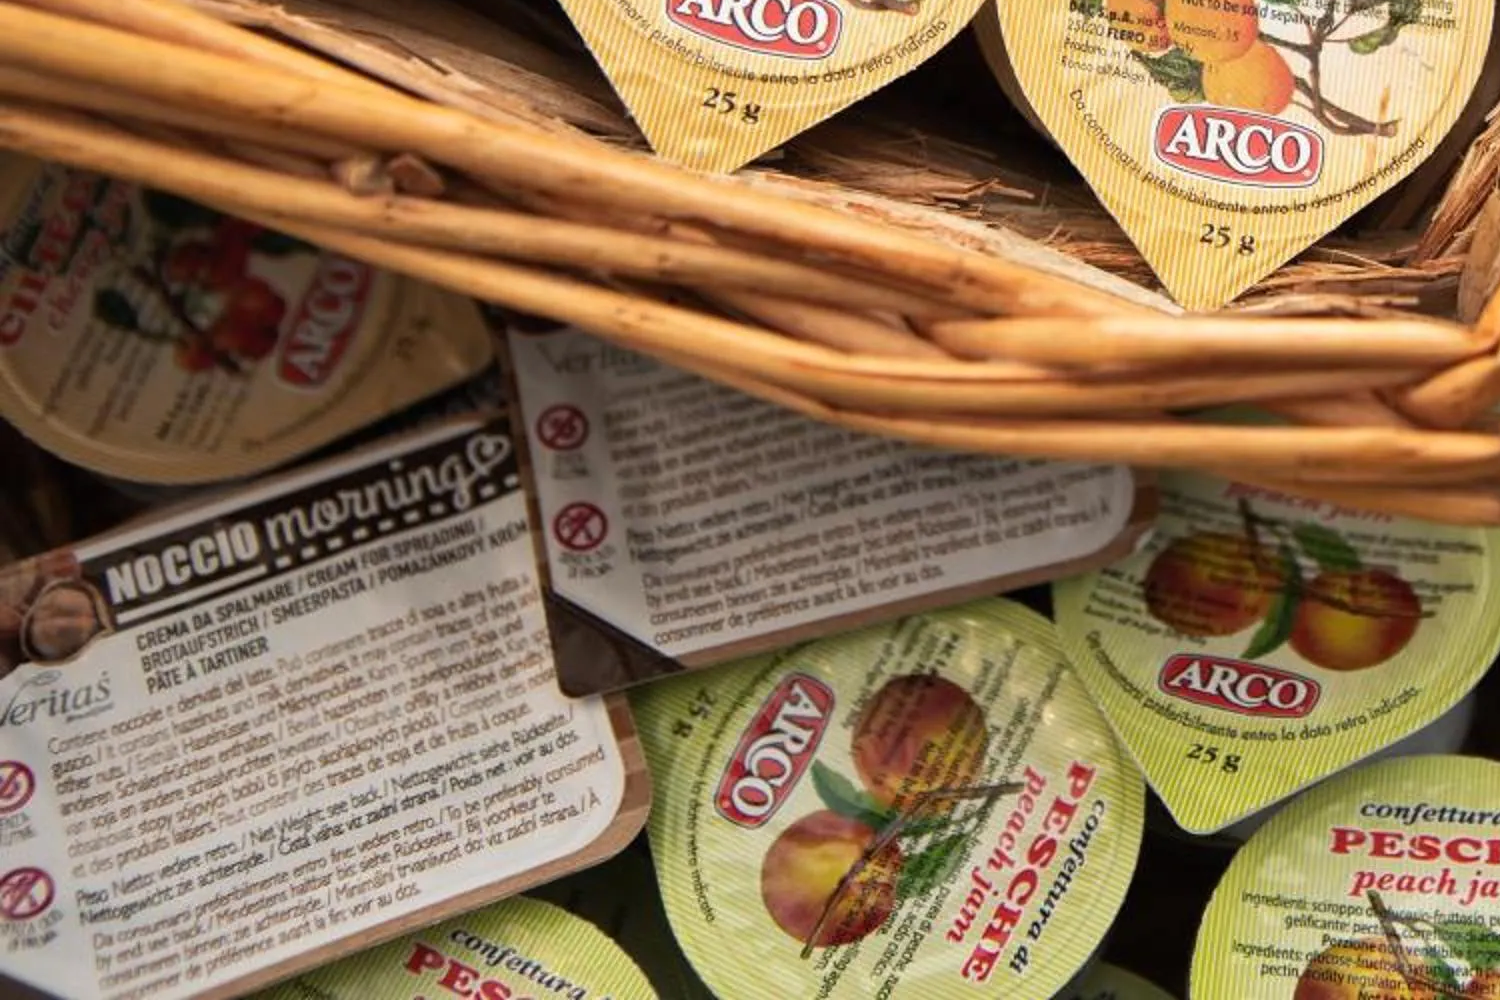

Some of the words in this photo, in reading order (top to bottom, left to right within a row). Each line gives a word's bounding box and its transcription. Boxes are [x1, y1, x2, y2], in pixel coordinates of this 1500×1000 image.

[1107, 27, 1145, 44] FLERO
[761, 73, 799, 85] entro
[803, 72, 818, 85] la
[823, 66, 856, 83] data
[859, 53, 892, 74] retro
[703, 88, 737, 110] 25
[742, 101, 762, 123] g
[1069, 89, 1085, 112] Da
[1083, 111, 1143, 176] consumarsi
[1142, 170, 1251, 215] preferibilmente
[1251, 204, 1291, 216] entro
[1293, 201, 1307, 214] la
[1311, 190, 1342, 211] data
[1345, 175, 1378, 201] retro
[1166, 114, 1310, 174] ARCO
[1200, 224, 1231, 248] 25
[1238, 238, 1256, 254] g
[105, 521, 259, 604] NOCCIO
[265, 450, 472, 550] morning
[136, 622, 190, 651] CREMA
[192, 613, 213, 631] DA
[215, 583, 294, 620] SPALMARE
[307, 562, 358, 588] CREAM
[361, 549, 391, 569] FOR
[393, 521, 476, 558] SPREADING
[141, 619, 259, 672] BROTAUFSTRICH
[272, 579, 366, 625] SMEERPASTA
[200, 636, 269, 672] TARTINER
[1168, 667, 1306, 709] ARCO
[1241, 729, 1276, 741] entro
[1281, 727, 1295, 740] la
[1301, 725, 1332, 740] data
[1335, 716, 1367, 732] retro
[1369, 686, 1421, 720] indicato.
[732, 683, 819, 815] ARCO
[1186, 745, 1218, 762] 25
[1221, 754, 1242, 772] g
[987, 764, 1047, 876] peach
[961, 762, 1097, 980] PESCHE
[1028, 800, 1105, 943] confettura
[1347, 868, 1456, 895] peach
[946, 866, 996, 943] jam
[1312, 900, 1363, 917] sciroppo
[403, 942, 533, 1000] PES
[451, 928, 588, 1000] confettura
[1009, 947, 1029, 974] di
